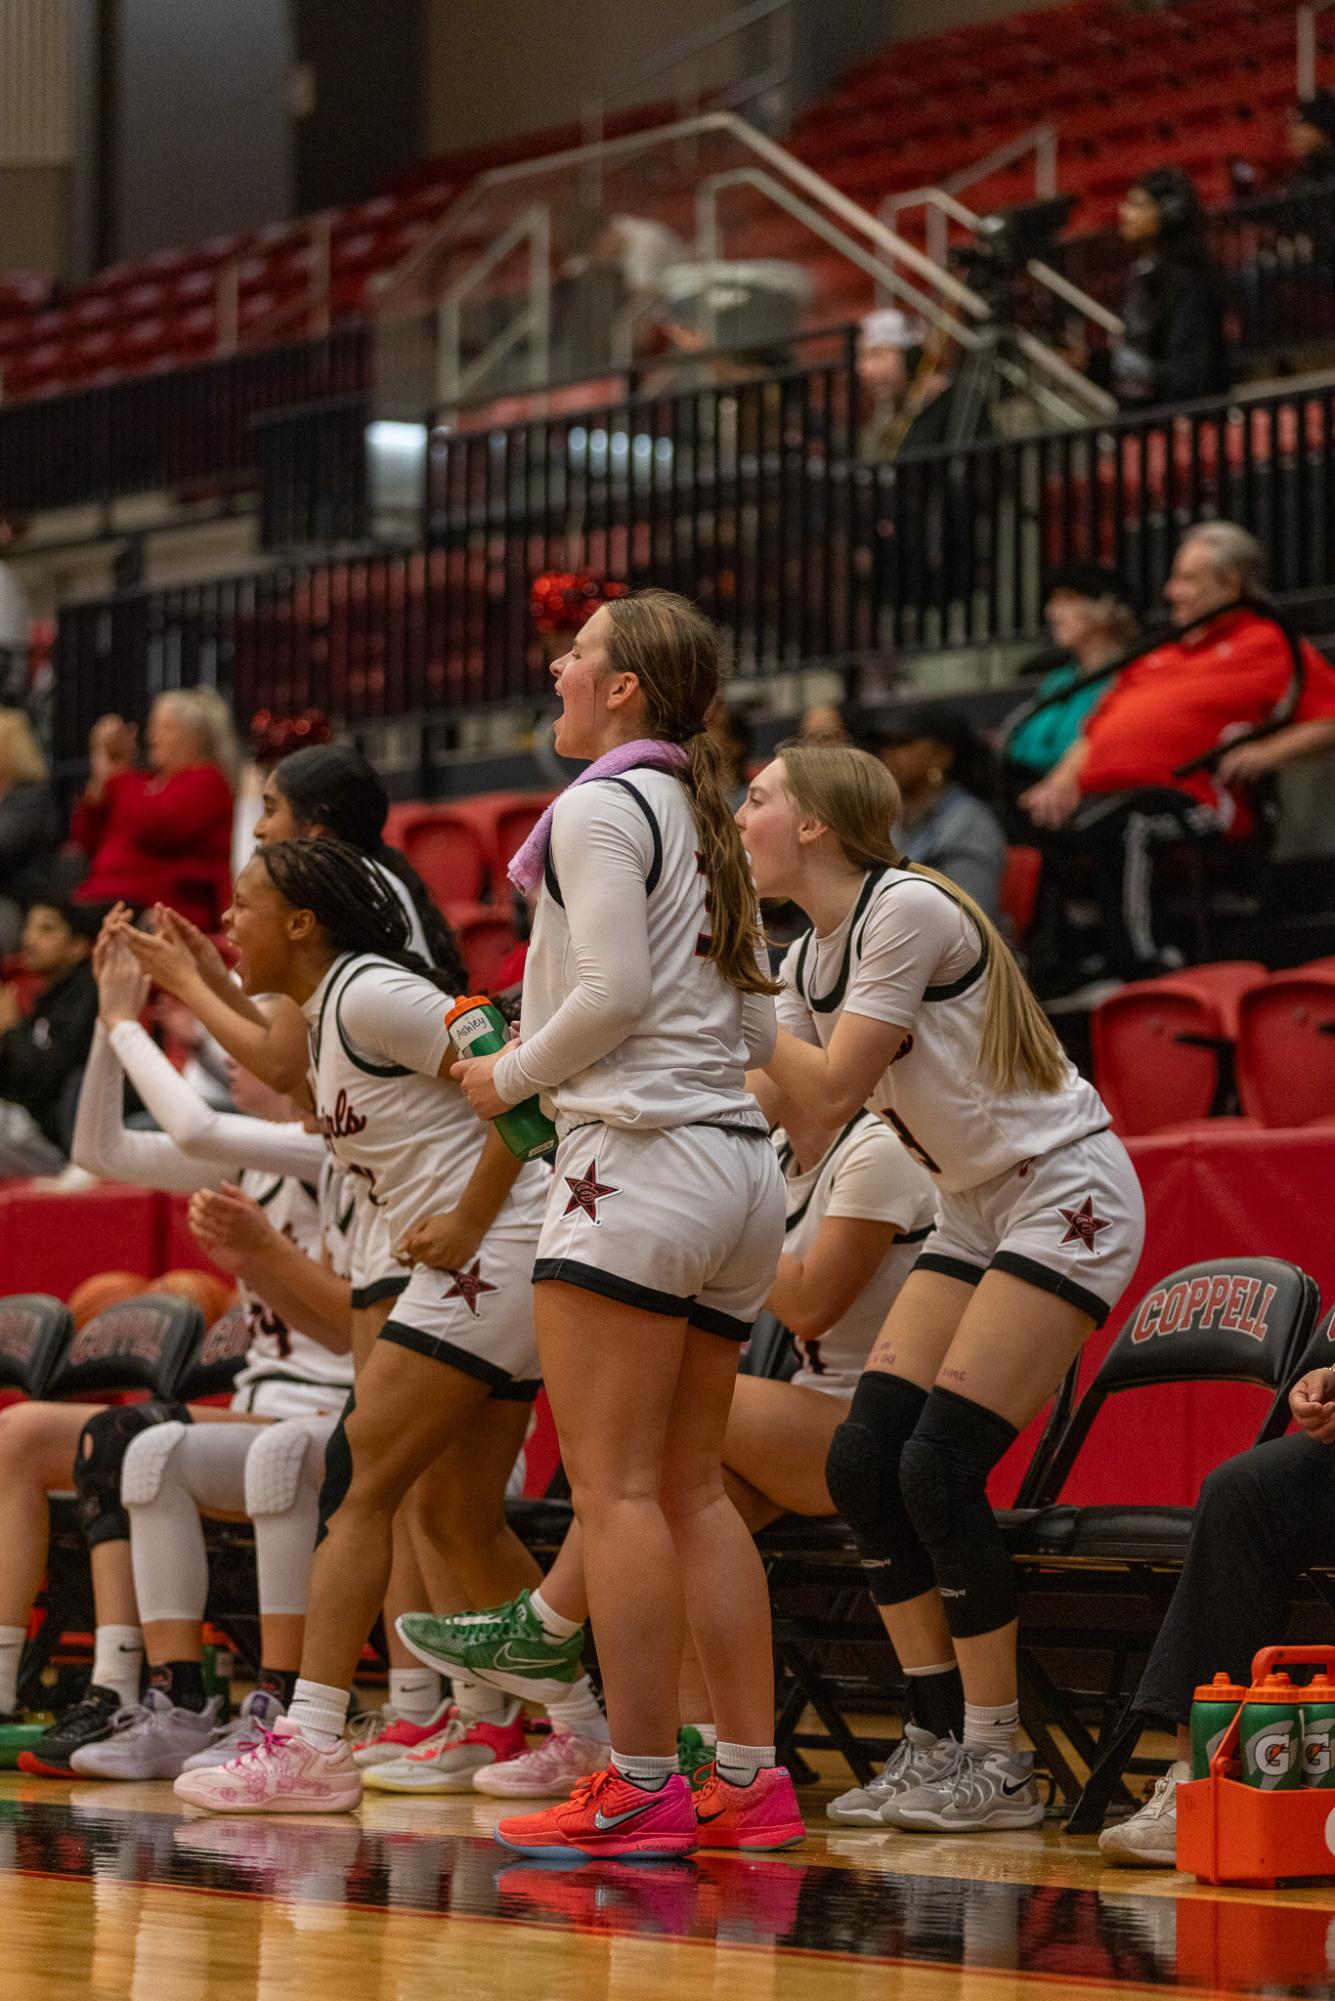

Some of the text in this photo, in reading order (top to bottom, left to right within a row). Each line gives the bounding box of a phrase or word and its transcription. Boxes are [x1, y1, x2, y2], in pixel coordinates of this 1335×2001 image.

[456, 1018, 487, 1040] Ashley
[1130, 1274, 1278, 1345] COPPELL
[1254, 1732, 1291, 1776] G
[1301, 1731, 1331, 1776] G
